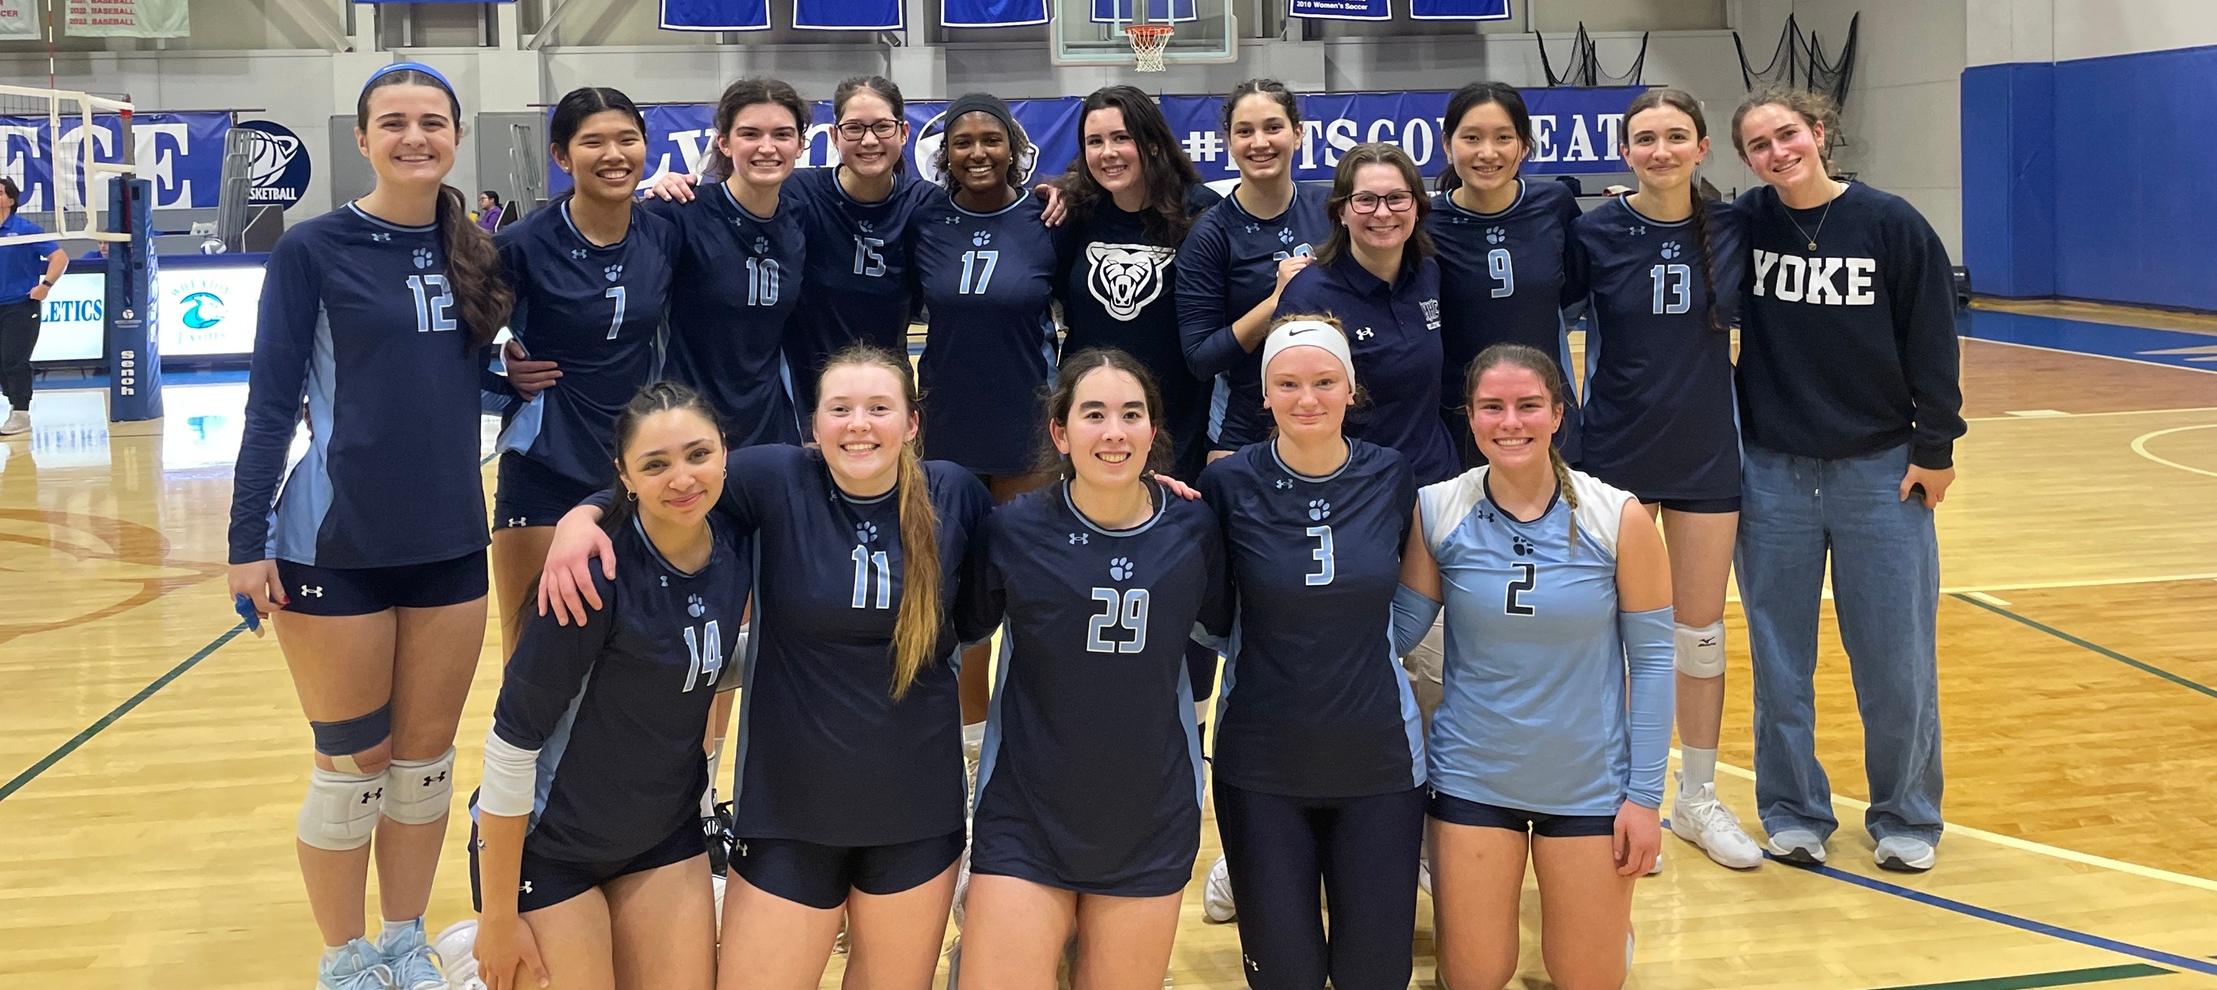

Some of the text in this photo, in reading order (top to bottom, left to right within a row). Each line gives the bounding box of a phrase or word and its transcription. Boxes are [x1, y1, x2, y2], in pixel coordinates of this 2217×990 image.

[1313, 1, 1344, 9] Women's
[1345, 2, 1368, 10] Soccer
[248, 187, 298, 201] SKETBALL
[746, 256, 779, 306] 10
[854, 233, 887, 277] 15
[959, 250, 999, 295] 17
[1488, 248, 1514, 299] 9
[1753, 248, 1876, 306] YOKE
[406, 275, 458, 332] 12
[606, 286, 626, 340] 7
[1650, 264, 1691, 314] 13
[852, 544, 891, 609] 11
[1305, 525, 1335, 586] 3
[1504, 562, 1536, 617] 2
[1086, 587, 1150, 653] 29
[682, 619, 723, 693] 14
